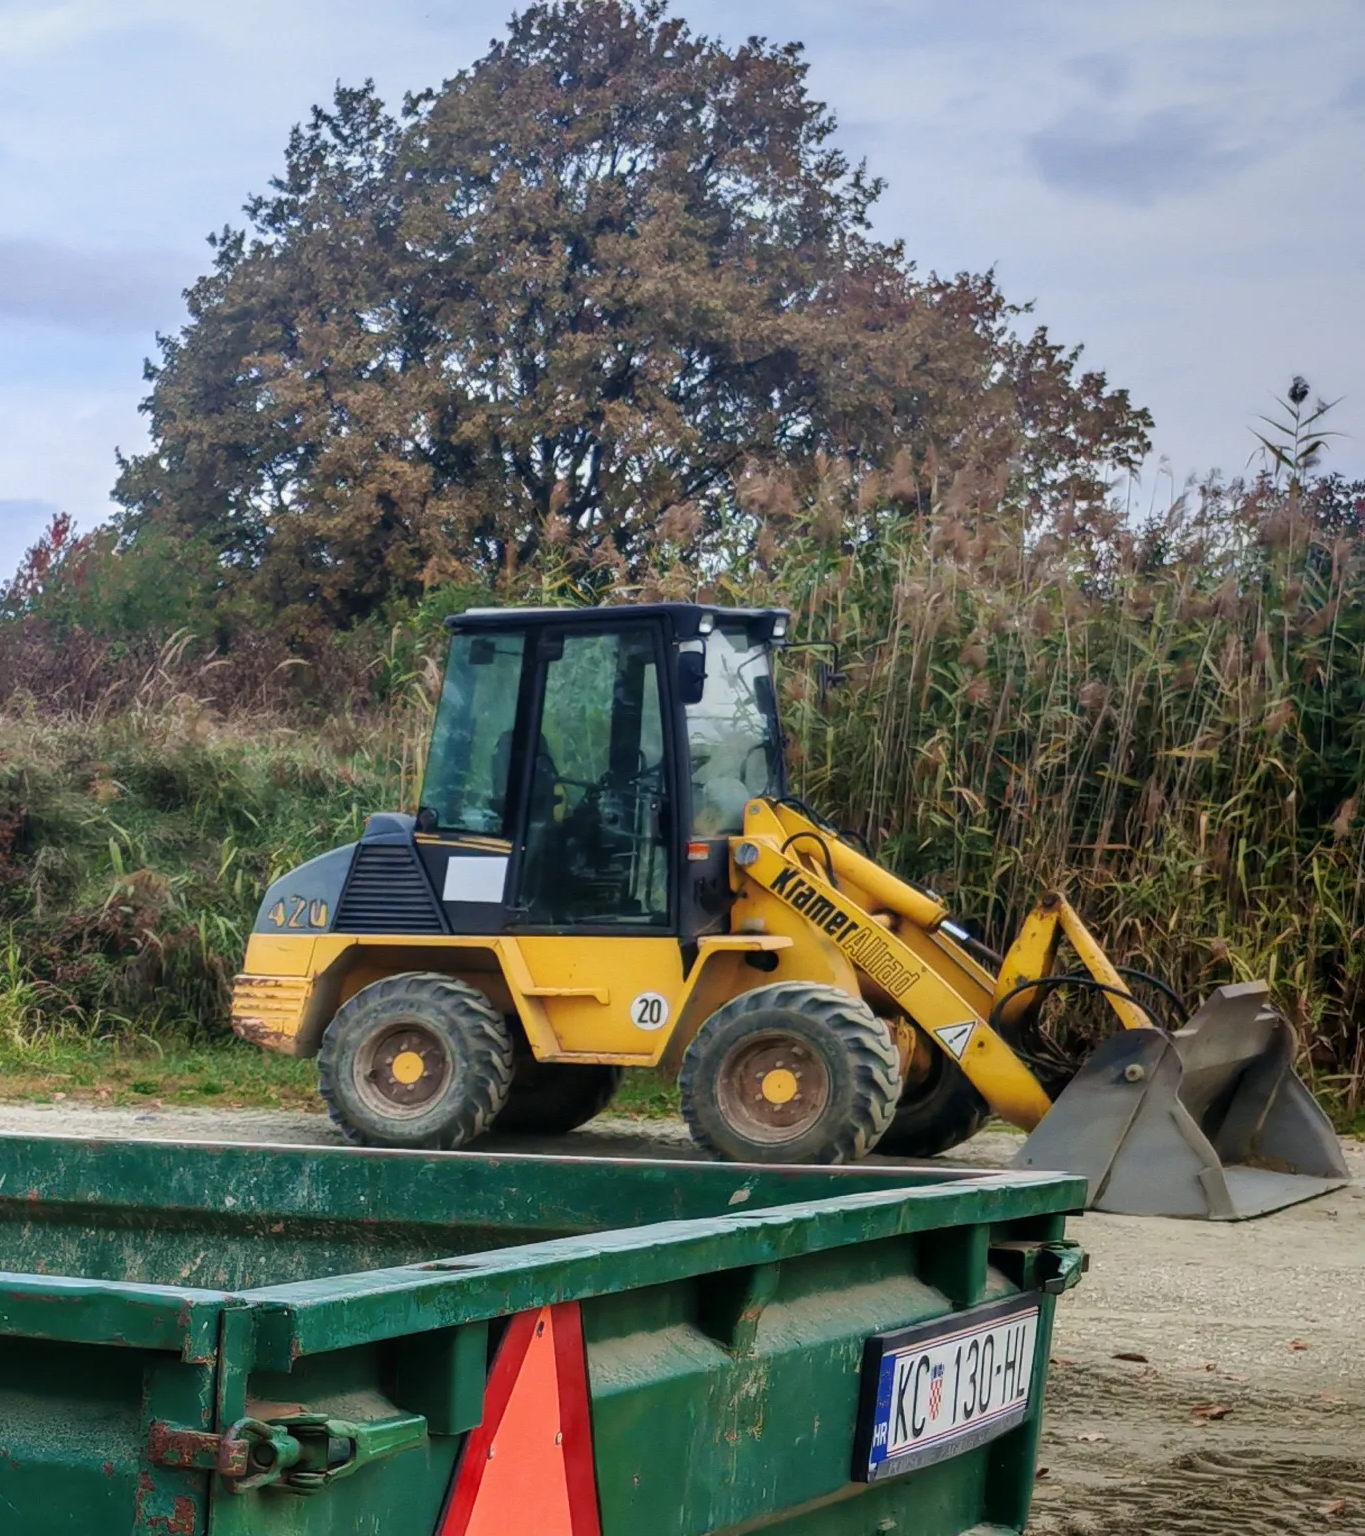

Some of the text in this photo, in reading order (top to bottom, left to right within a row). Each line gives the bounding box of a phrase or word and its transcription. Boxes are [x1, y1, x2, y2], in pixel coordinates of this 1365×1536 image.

[637, 998, 662, 1024] 20
[893, 1355, 930, 1445] KC
[952, 1325, 1026, 1425] 130-HL
[872, 1423, 888, 1447] HR
